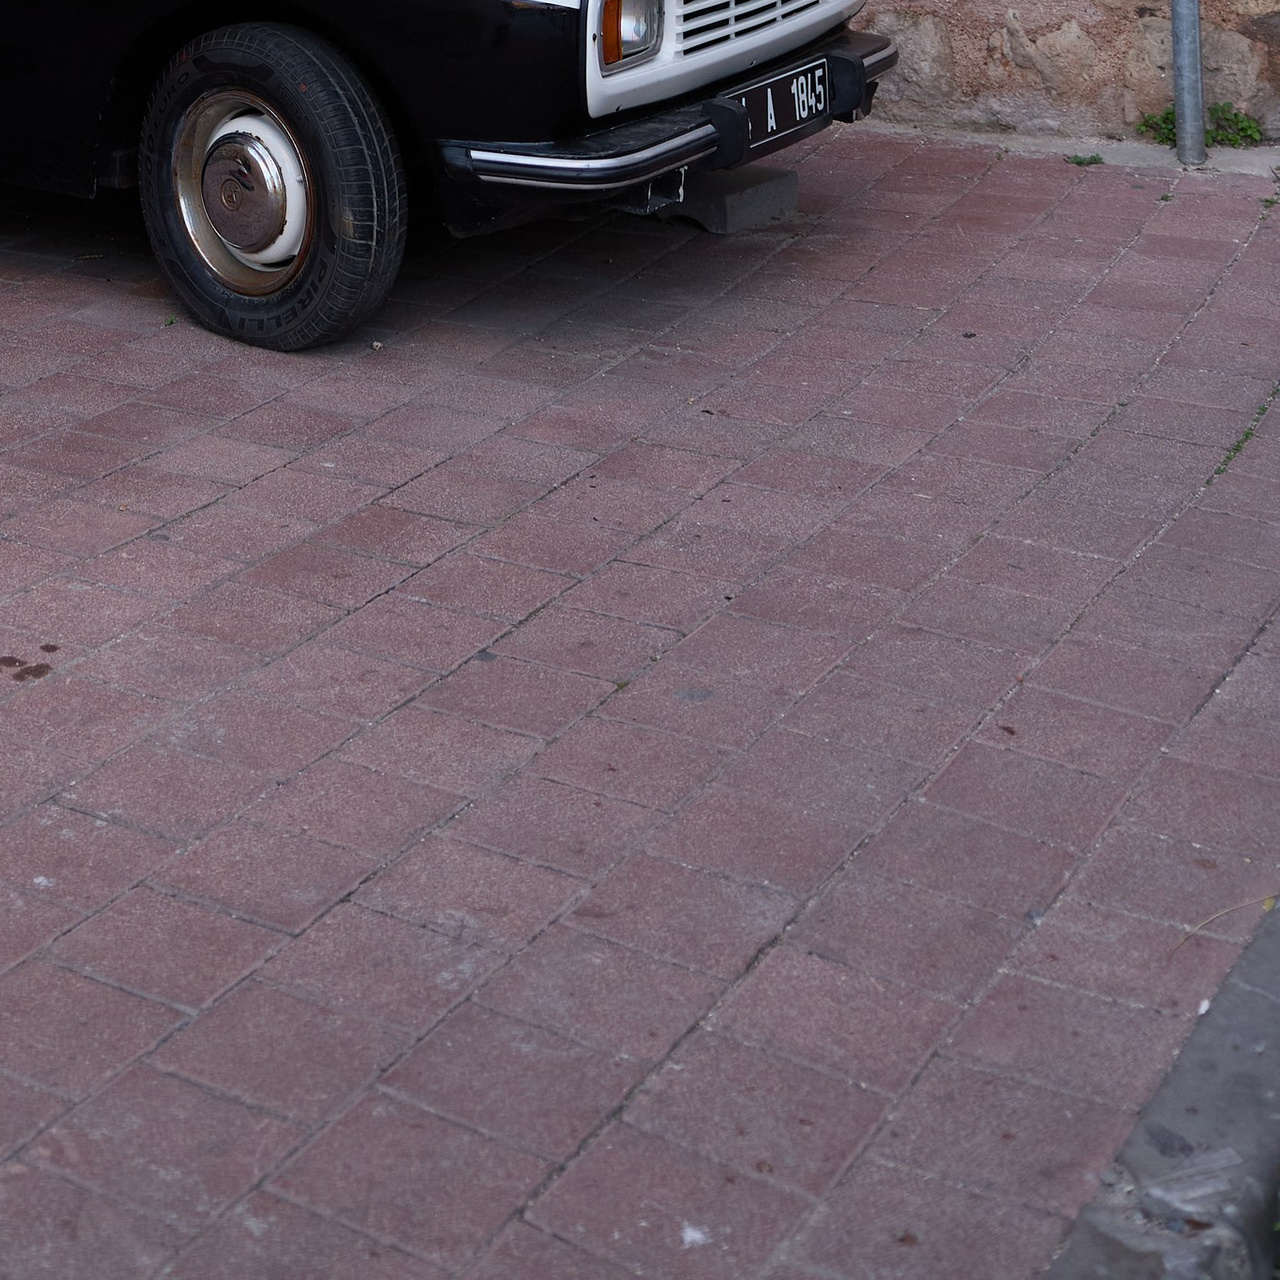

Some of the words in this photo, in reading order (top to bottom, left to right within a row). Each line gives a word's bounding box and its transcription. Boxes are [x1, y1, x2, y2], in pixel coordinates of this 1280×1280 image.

[767, 88, 777, 133] A
[791, 68, 824, 121] 1845
[238, 258, 328, 332] PIRELLI
